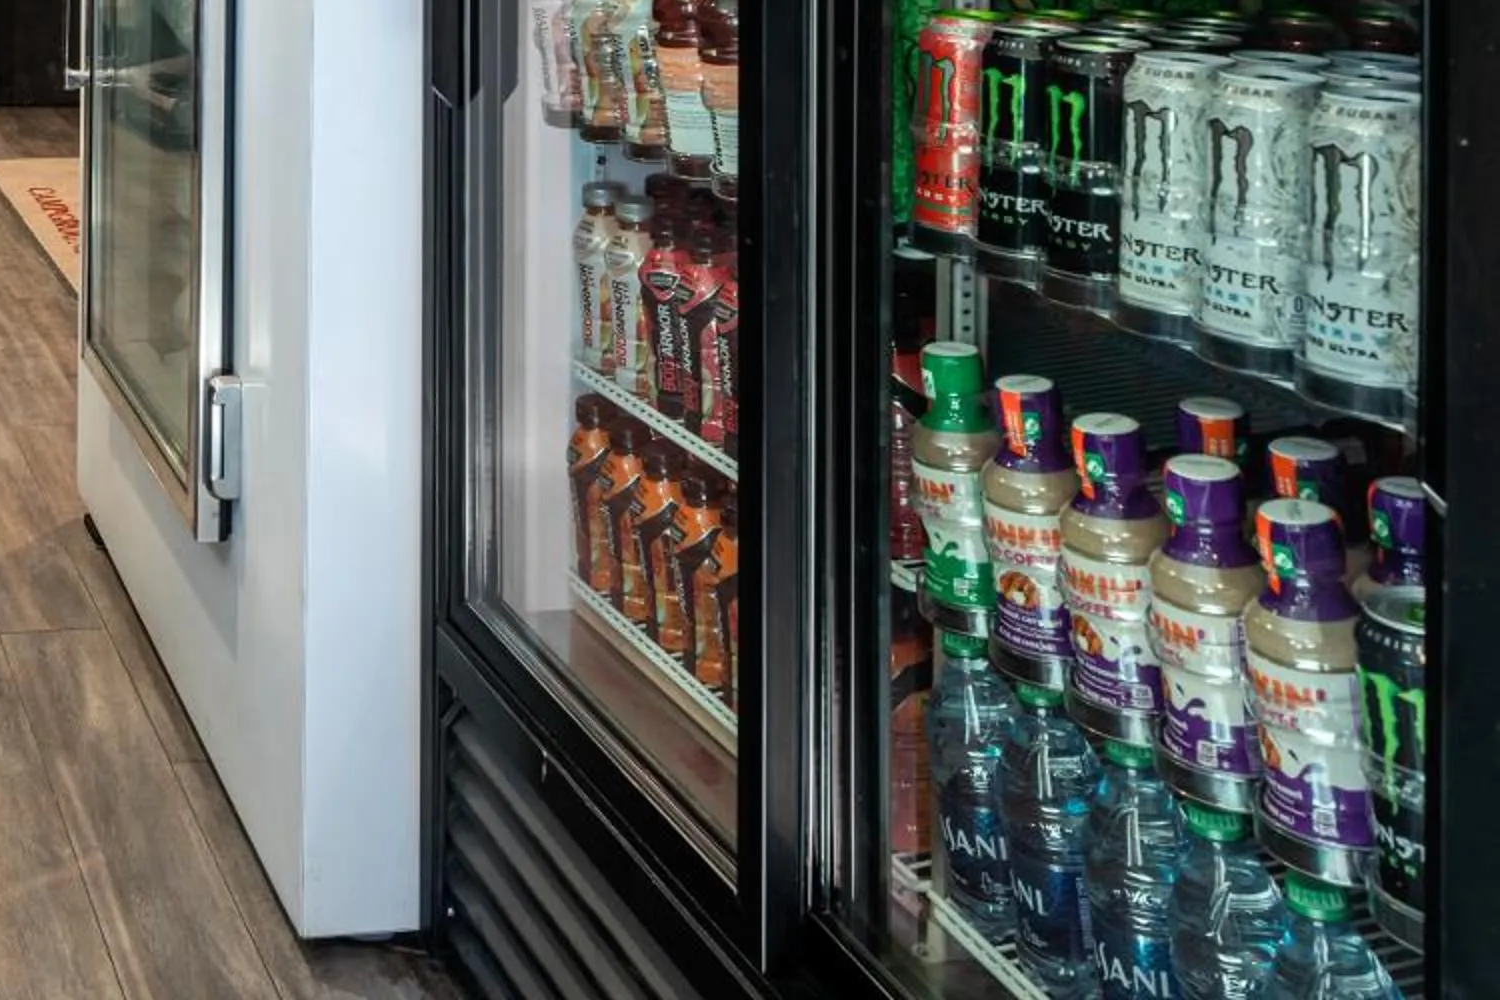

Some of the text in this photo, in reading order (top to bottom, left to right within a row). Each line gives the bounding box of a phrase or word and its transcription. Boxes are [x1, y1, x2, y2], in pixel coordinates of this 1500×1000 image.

[979, 187, 1048, 217] NSTER
[1050, 211, 1112, 242] STER
[1121, 231, 1202, 266] NSTER
[1206, 263, 1280, 295] STER
[1308, 293, 1410, 334] NSTER
[1328, 341, 1380, 361] ULTRA
